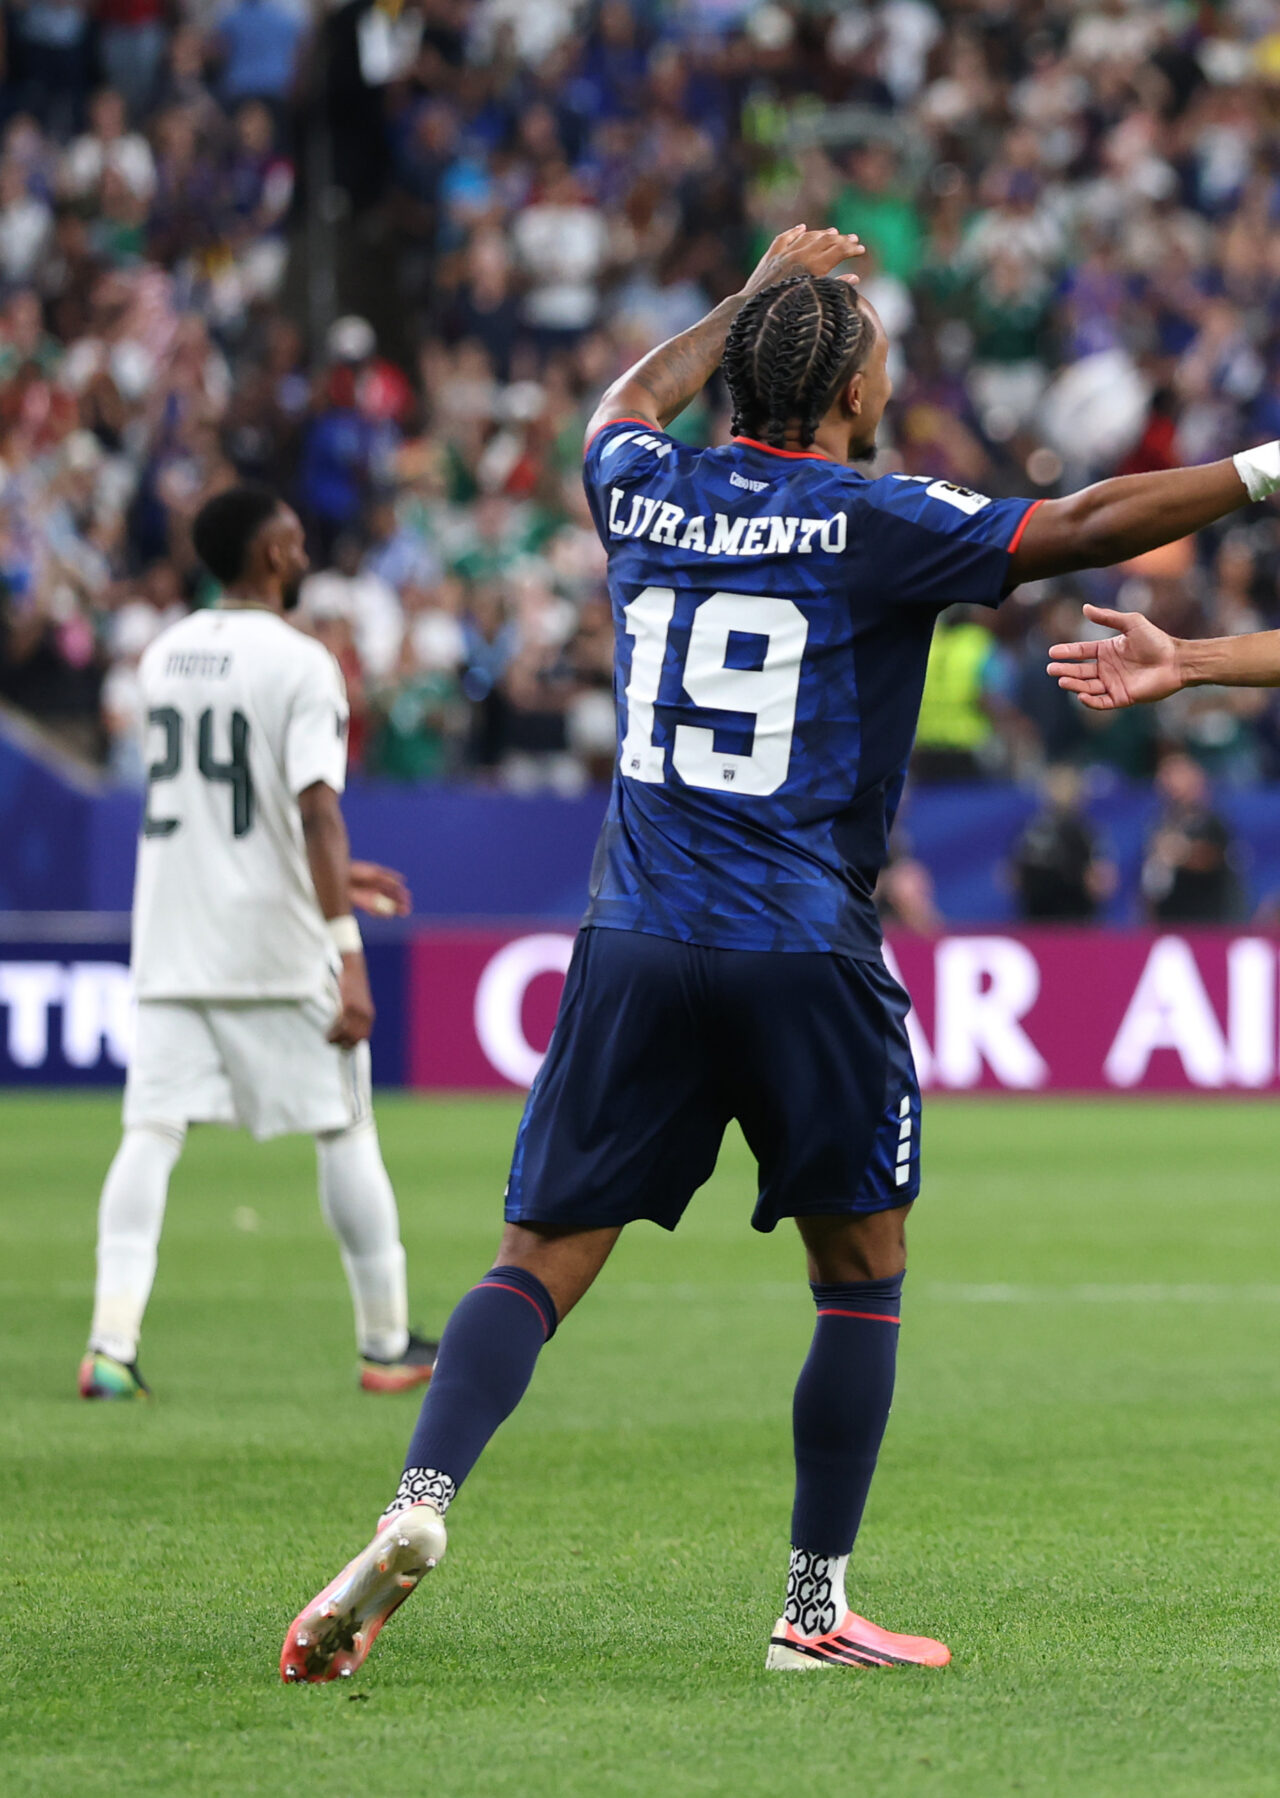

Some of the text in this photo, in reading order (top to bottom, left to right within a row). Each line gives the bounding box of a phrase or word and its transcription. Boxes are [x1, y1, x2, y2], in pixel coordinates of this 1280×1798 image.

[608, 487, 847, 556] LIVRAMENTO
[619, 586, 809, 797] 19
[144, 705, 254, 838] 24
